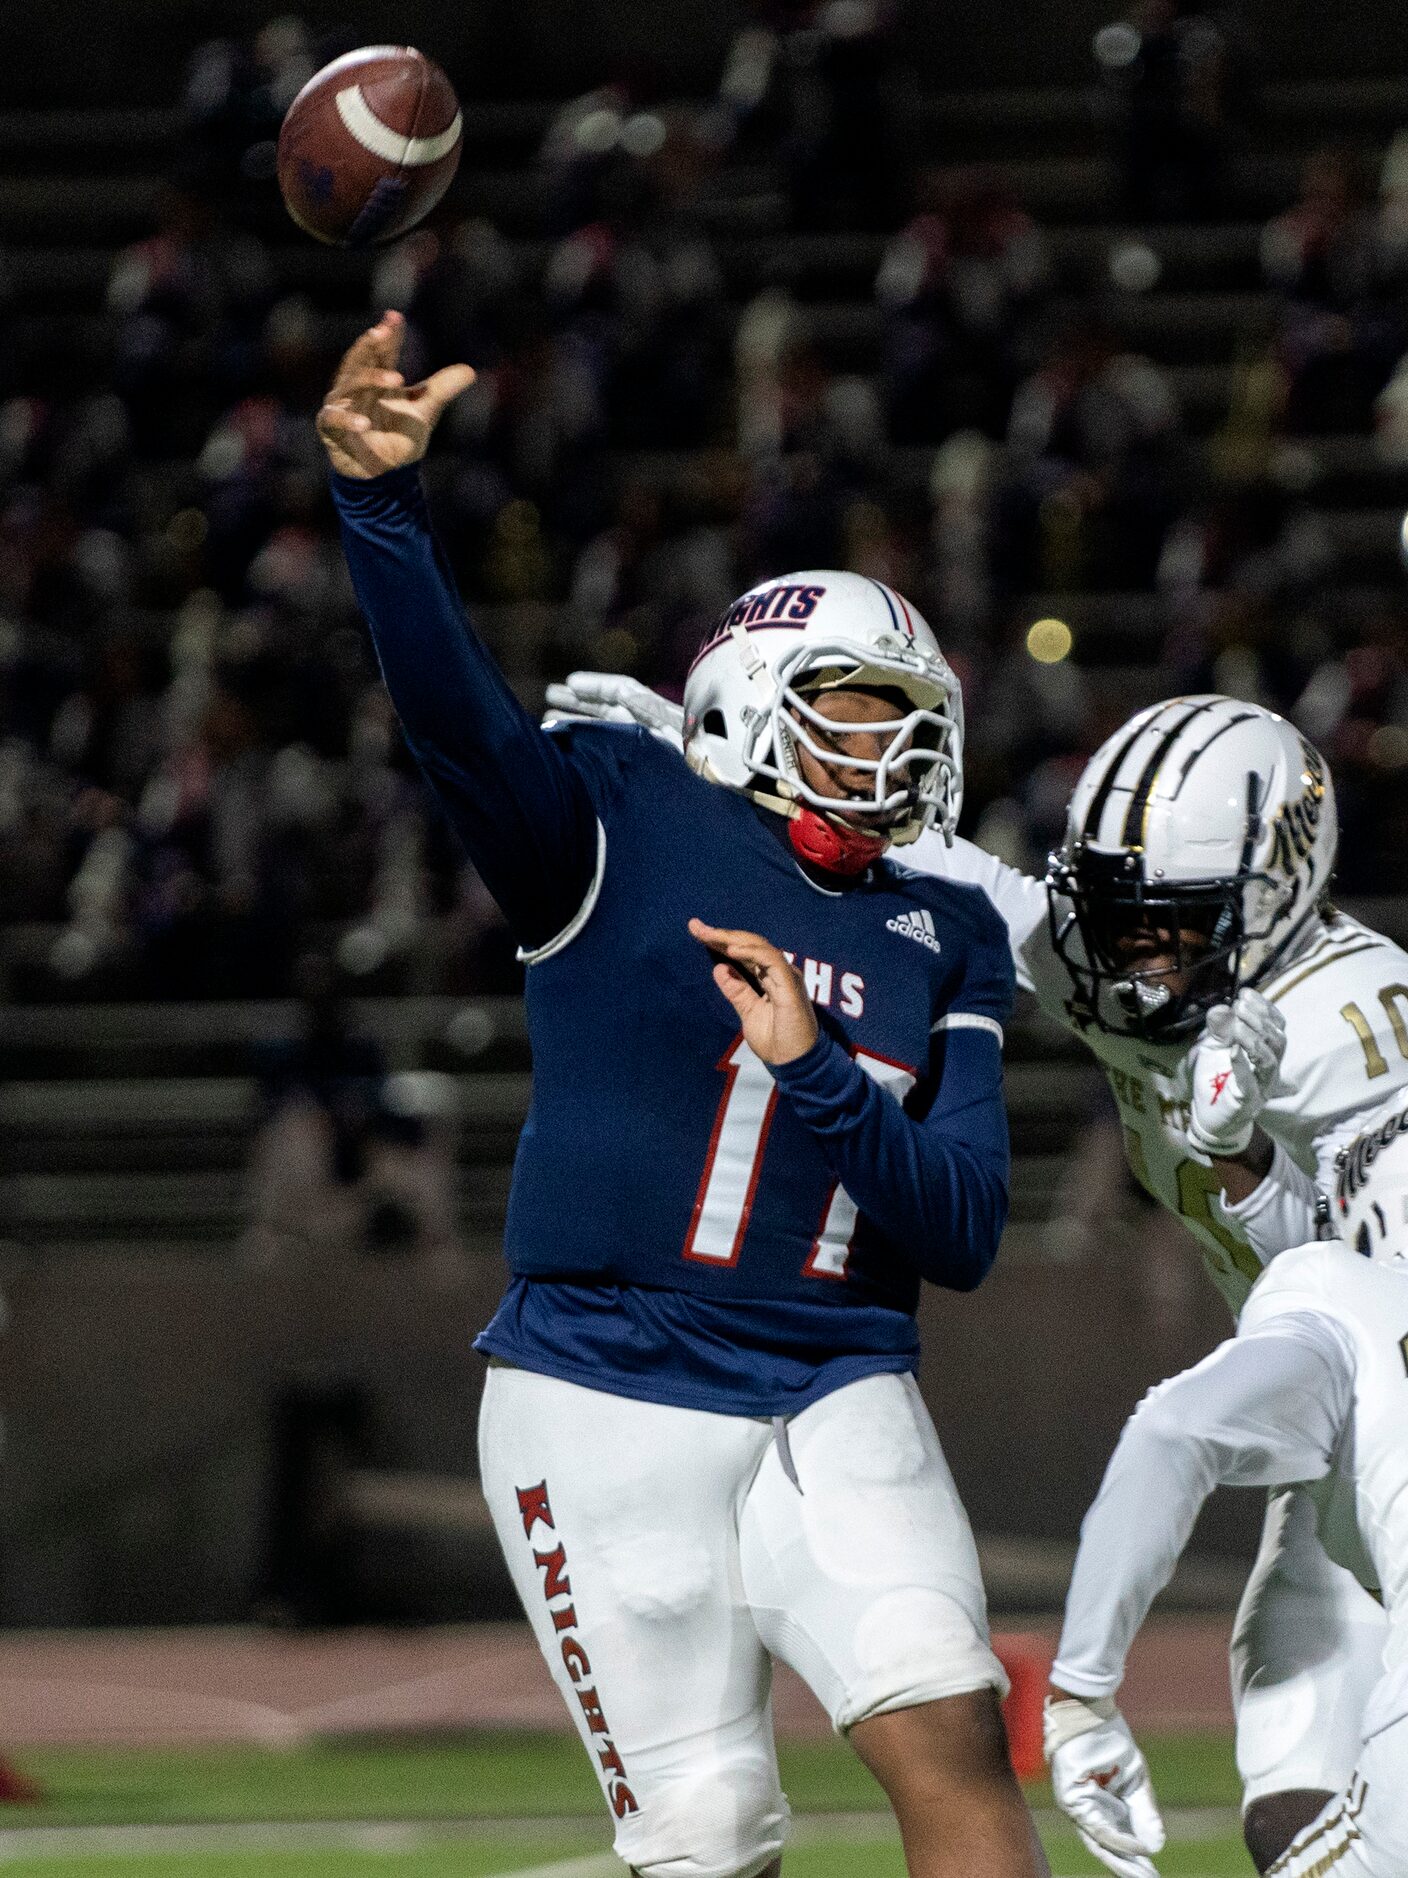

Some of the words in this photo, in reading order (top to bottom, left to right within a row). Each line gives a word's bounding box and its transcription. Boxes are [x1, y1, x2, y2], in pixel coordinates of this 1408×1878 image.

[885, 919, 941, 954] adidas
[781, 949, 866, 1019] HS
[514, 1479, 640, 1819] KNIGHTS
